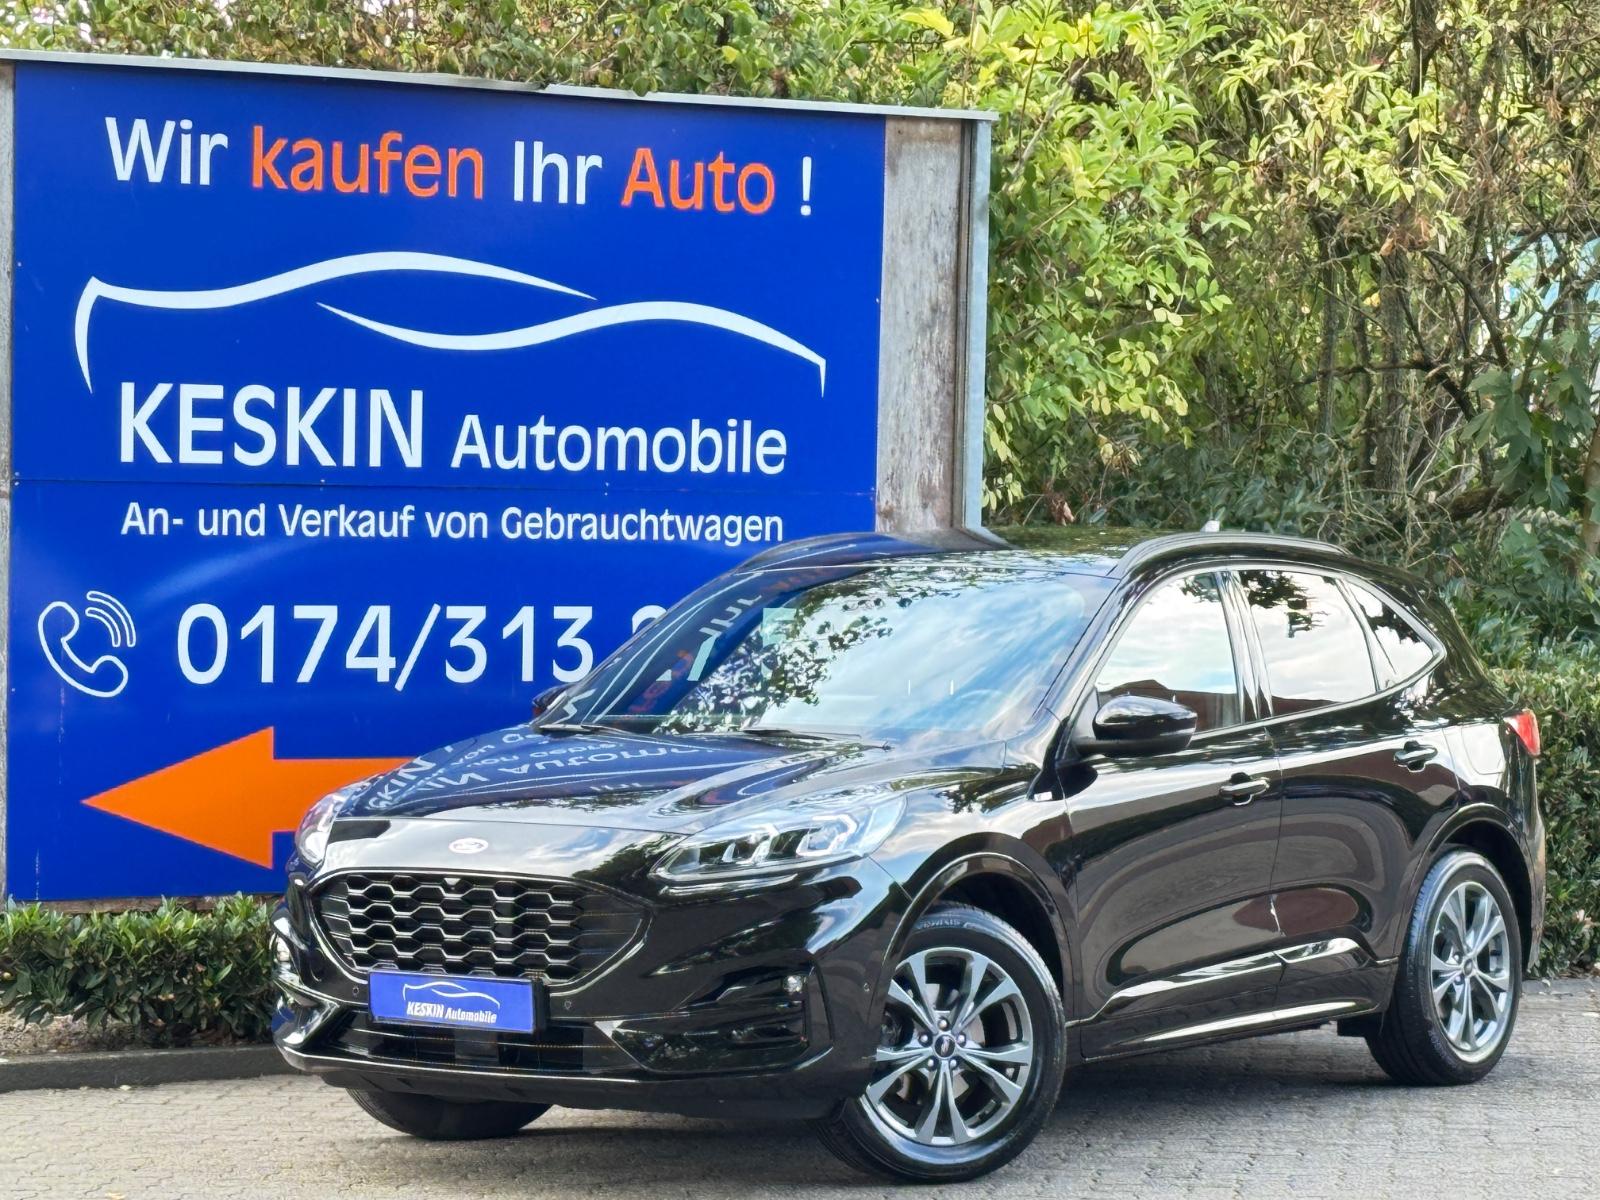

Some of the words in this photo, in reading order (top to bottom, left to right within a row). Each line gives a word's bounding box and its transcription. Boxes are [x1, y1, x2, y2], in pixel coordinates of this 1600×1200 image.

[104, 116, 229, 186] Wir
[251, 125, 484, 199] kaufen
[513, 140, 603, 205] Ihr
[621, 147, 776, 215] Auto
[800, 156, 812, 217] !
[120, 381, 423, 469] KESKIN
[450, 414, 788, 475] Automobile
[121, 501, 184, 536] An-
[198, 503, 266, 537] und
[278, 503, 416, 539] Verkauf
[425, 511, 488, 540] von
[501, 506, 783, 547] Gebrauchtwagen
[177, 603, 594, 692] 0174/313
[406, 1001, 445, 1018] KESKIN
[445, 1007, 498, 1024] Automobile
